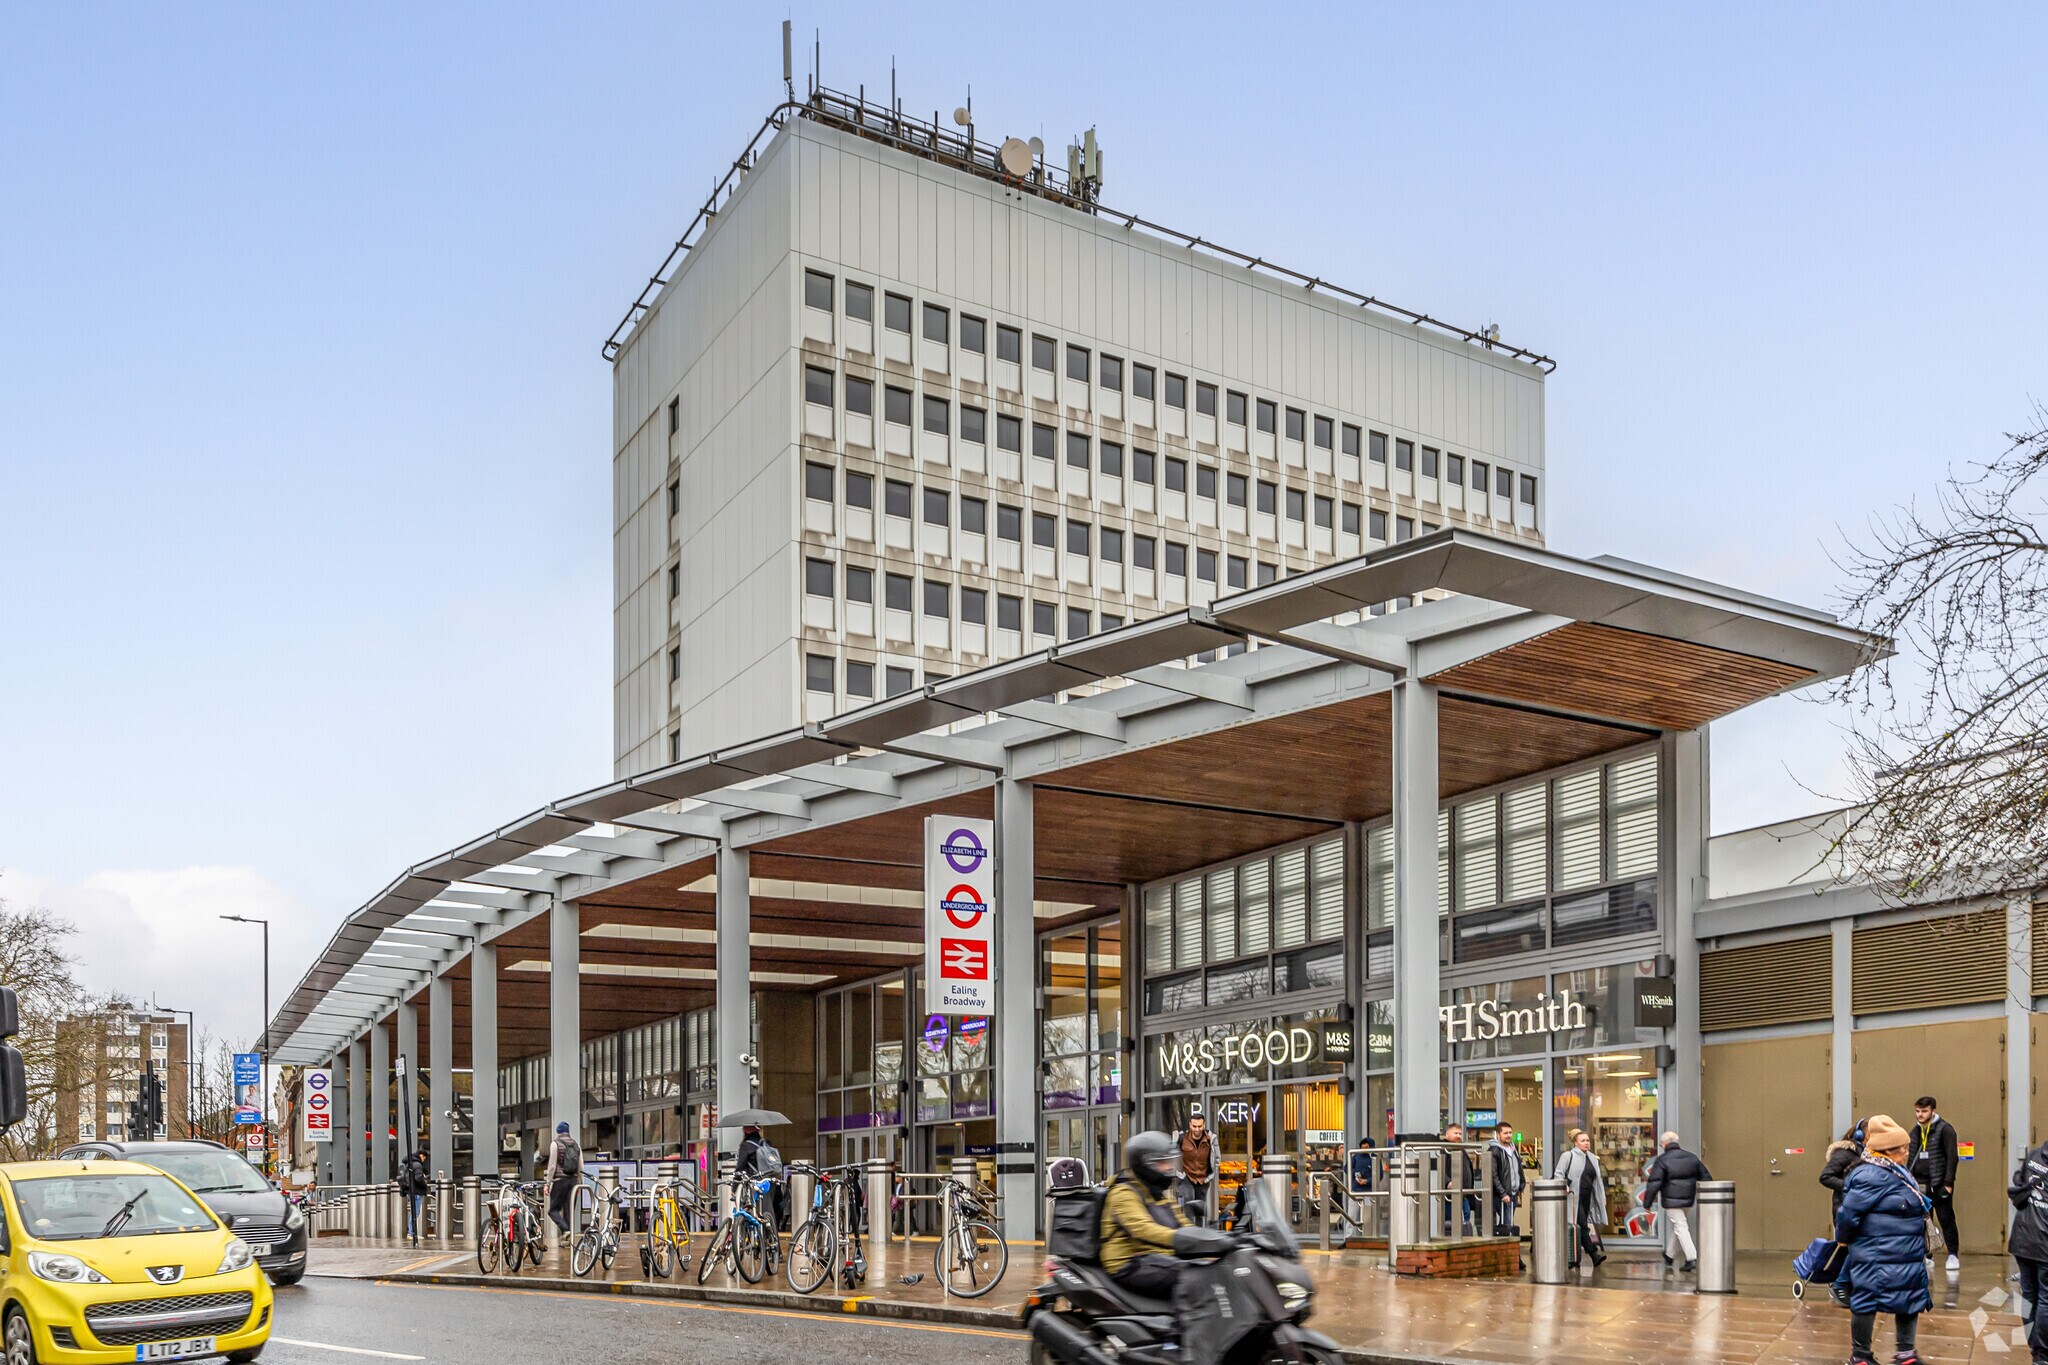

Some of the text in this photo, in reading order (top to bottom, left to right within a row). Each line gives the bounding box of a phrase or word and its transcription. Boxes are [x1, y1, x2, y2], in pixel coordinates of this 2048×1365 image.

[942, 846, 986, 857] ELIZABETH LINE
[942, 902, 986, 912] UNDERGROUND
[951, 985, 978, 998] Ealing
[943, 996, 986, 1008] Broadway
[1641, 994, 1674, 1006] WHSmith
[1439, 989, 1586, 1043] HSmith
[1326, 1032, 1350, 1046] M&S
[1159, 1028, 1312, 1078] M&S FOOD
[1190, 1102, 1260, 1123] BKERY
[1319, 1131, 1338, 1142] COFFEE
[149, 1338, 212, 1358] LT12 JBX
